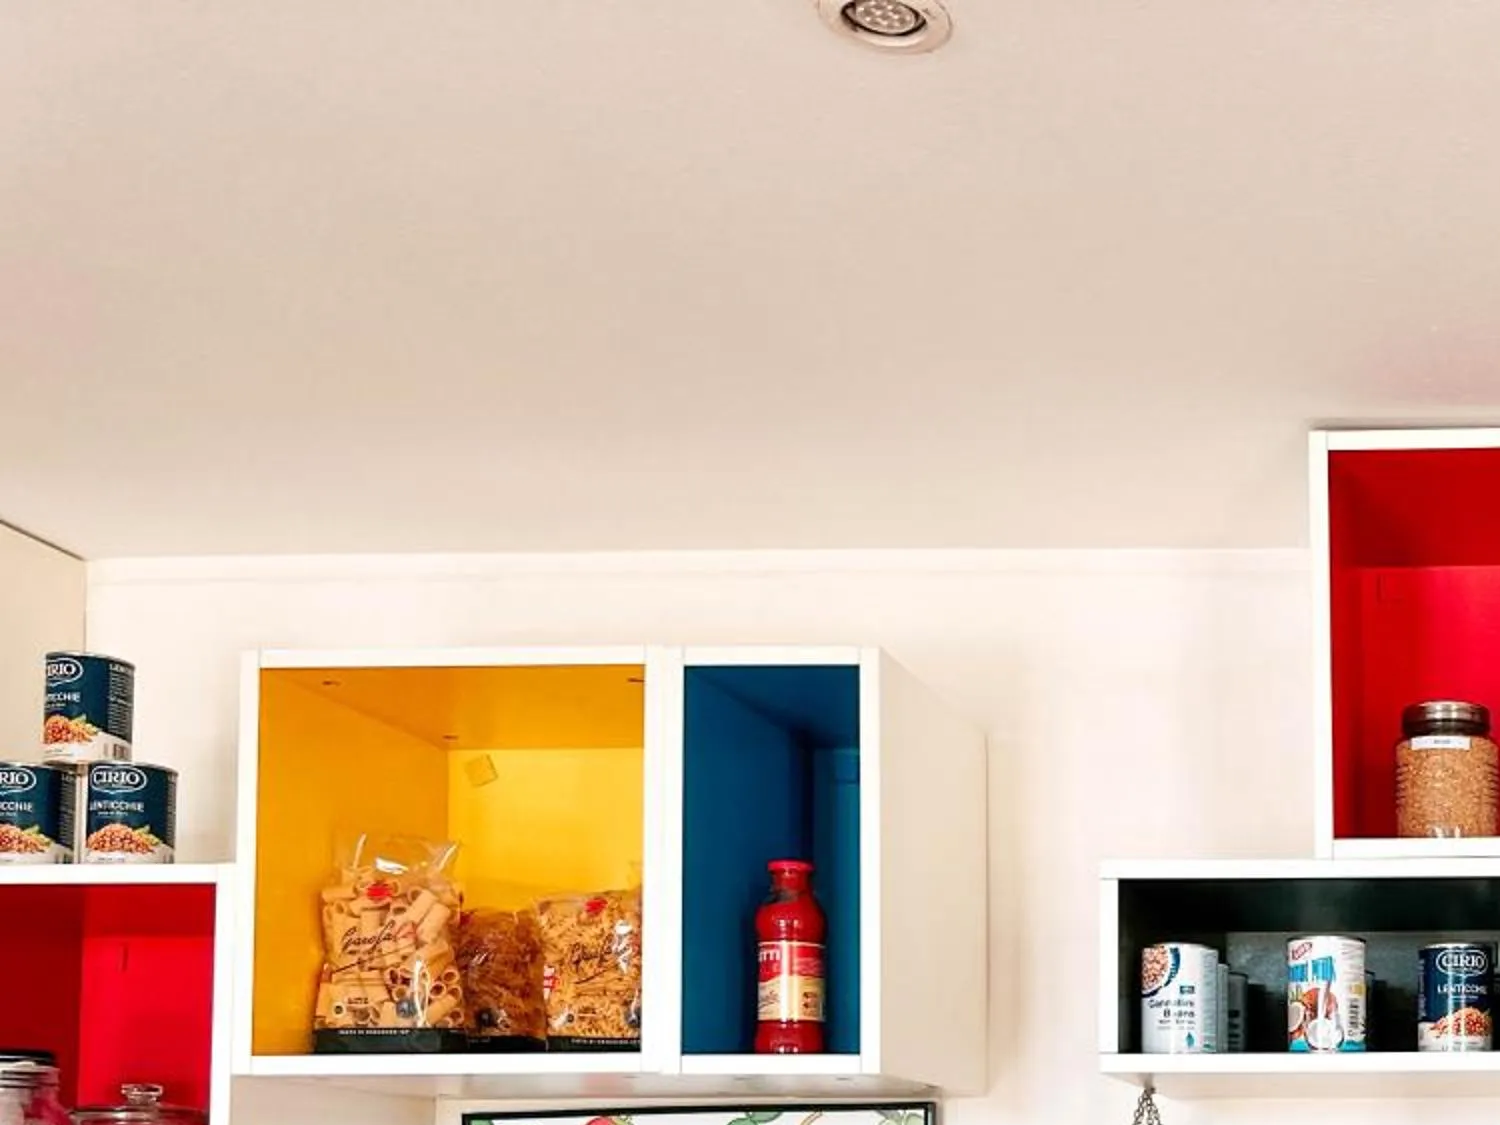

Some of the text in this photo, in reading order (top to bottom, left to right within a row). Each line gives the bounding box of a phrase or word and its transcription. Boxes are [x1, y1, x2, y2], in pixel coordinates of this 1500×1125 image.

[0, 771, 28, 784] RIO
[93, 771, 140, 785] CIRIO
[1442, 954, 1485, 968] CIRIO
